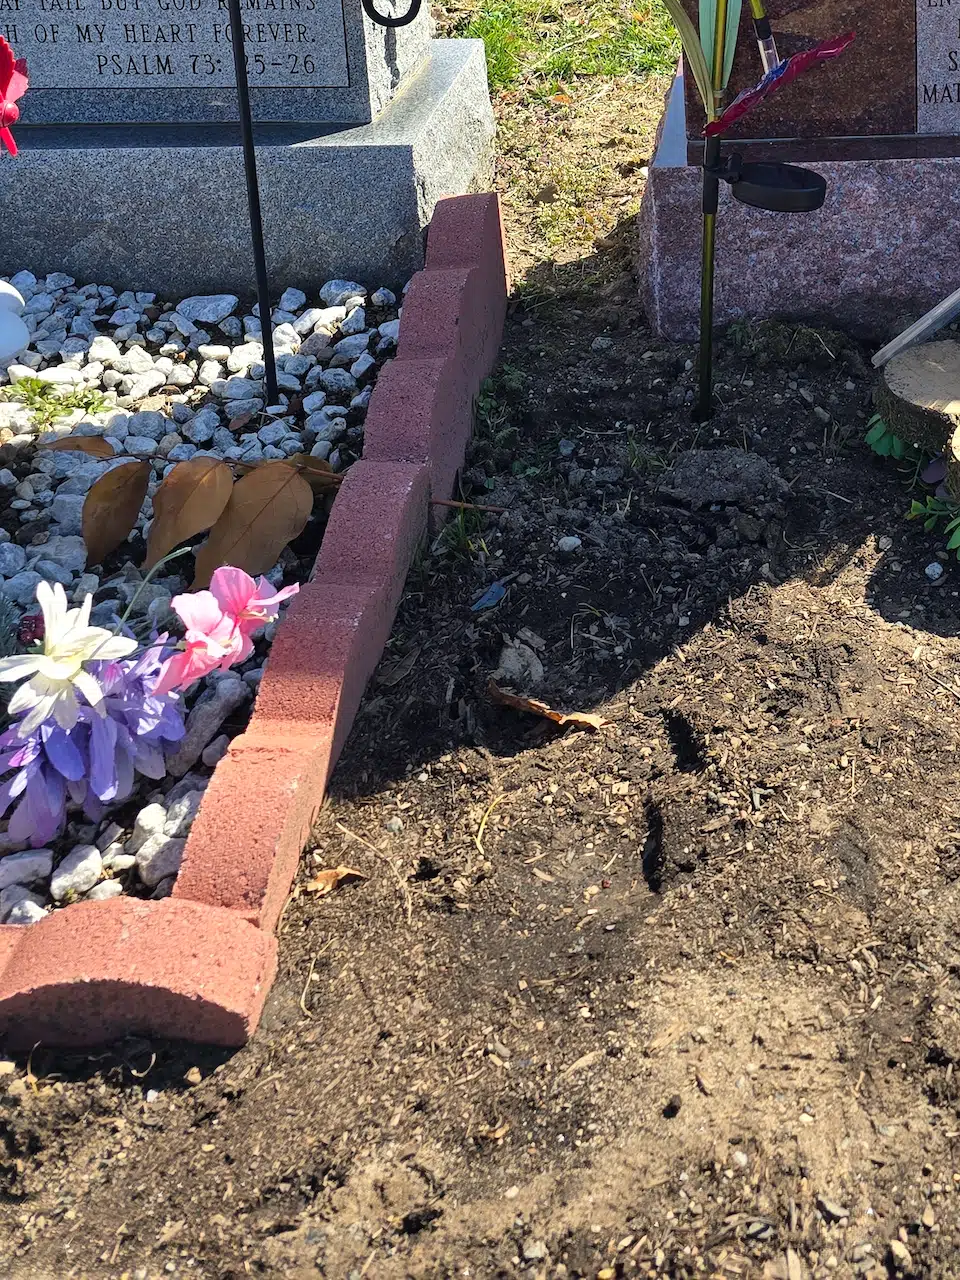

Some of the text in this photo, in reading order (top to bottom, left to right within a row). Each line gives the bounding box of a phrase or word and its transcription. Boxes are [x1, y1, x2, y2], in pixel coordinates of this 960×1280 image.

[34, 24, 60, 44] OF
[76, 24, 107, 43] MY
[124, 23, 198, 43] HEART
[97, 54, 175, 75] PSALM
